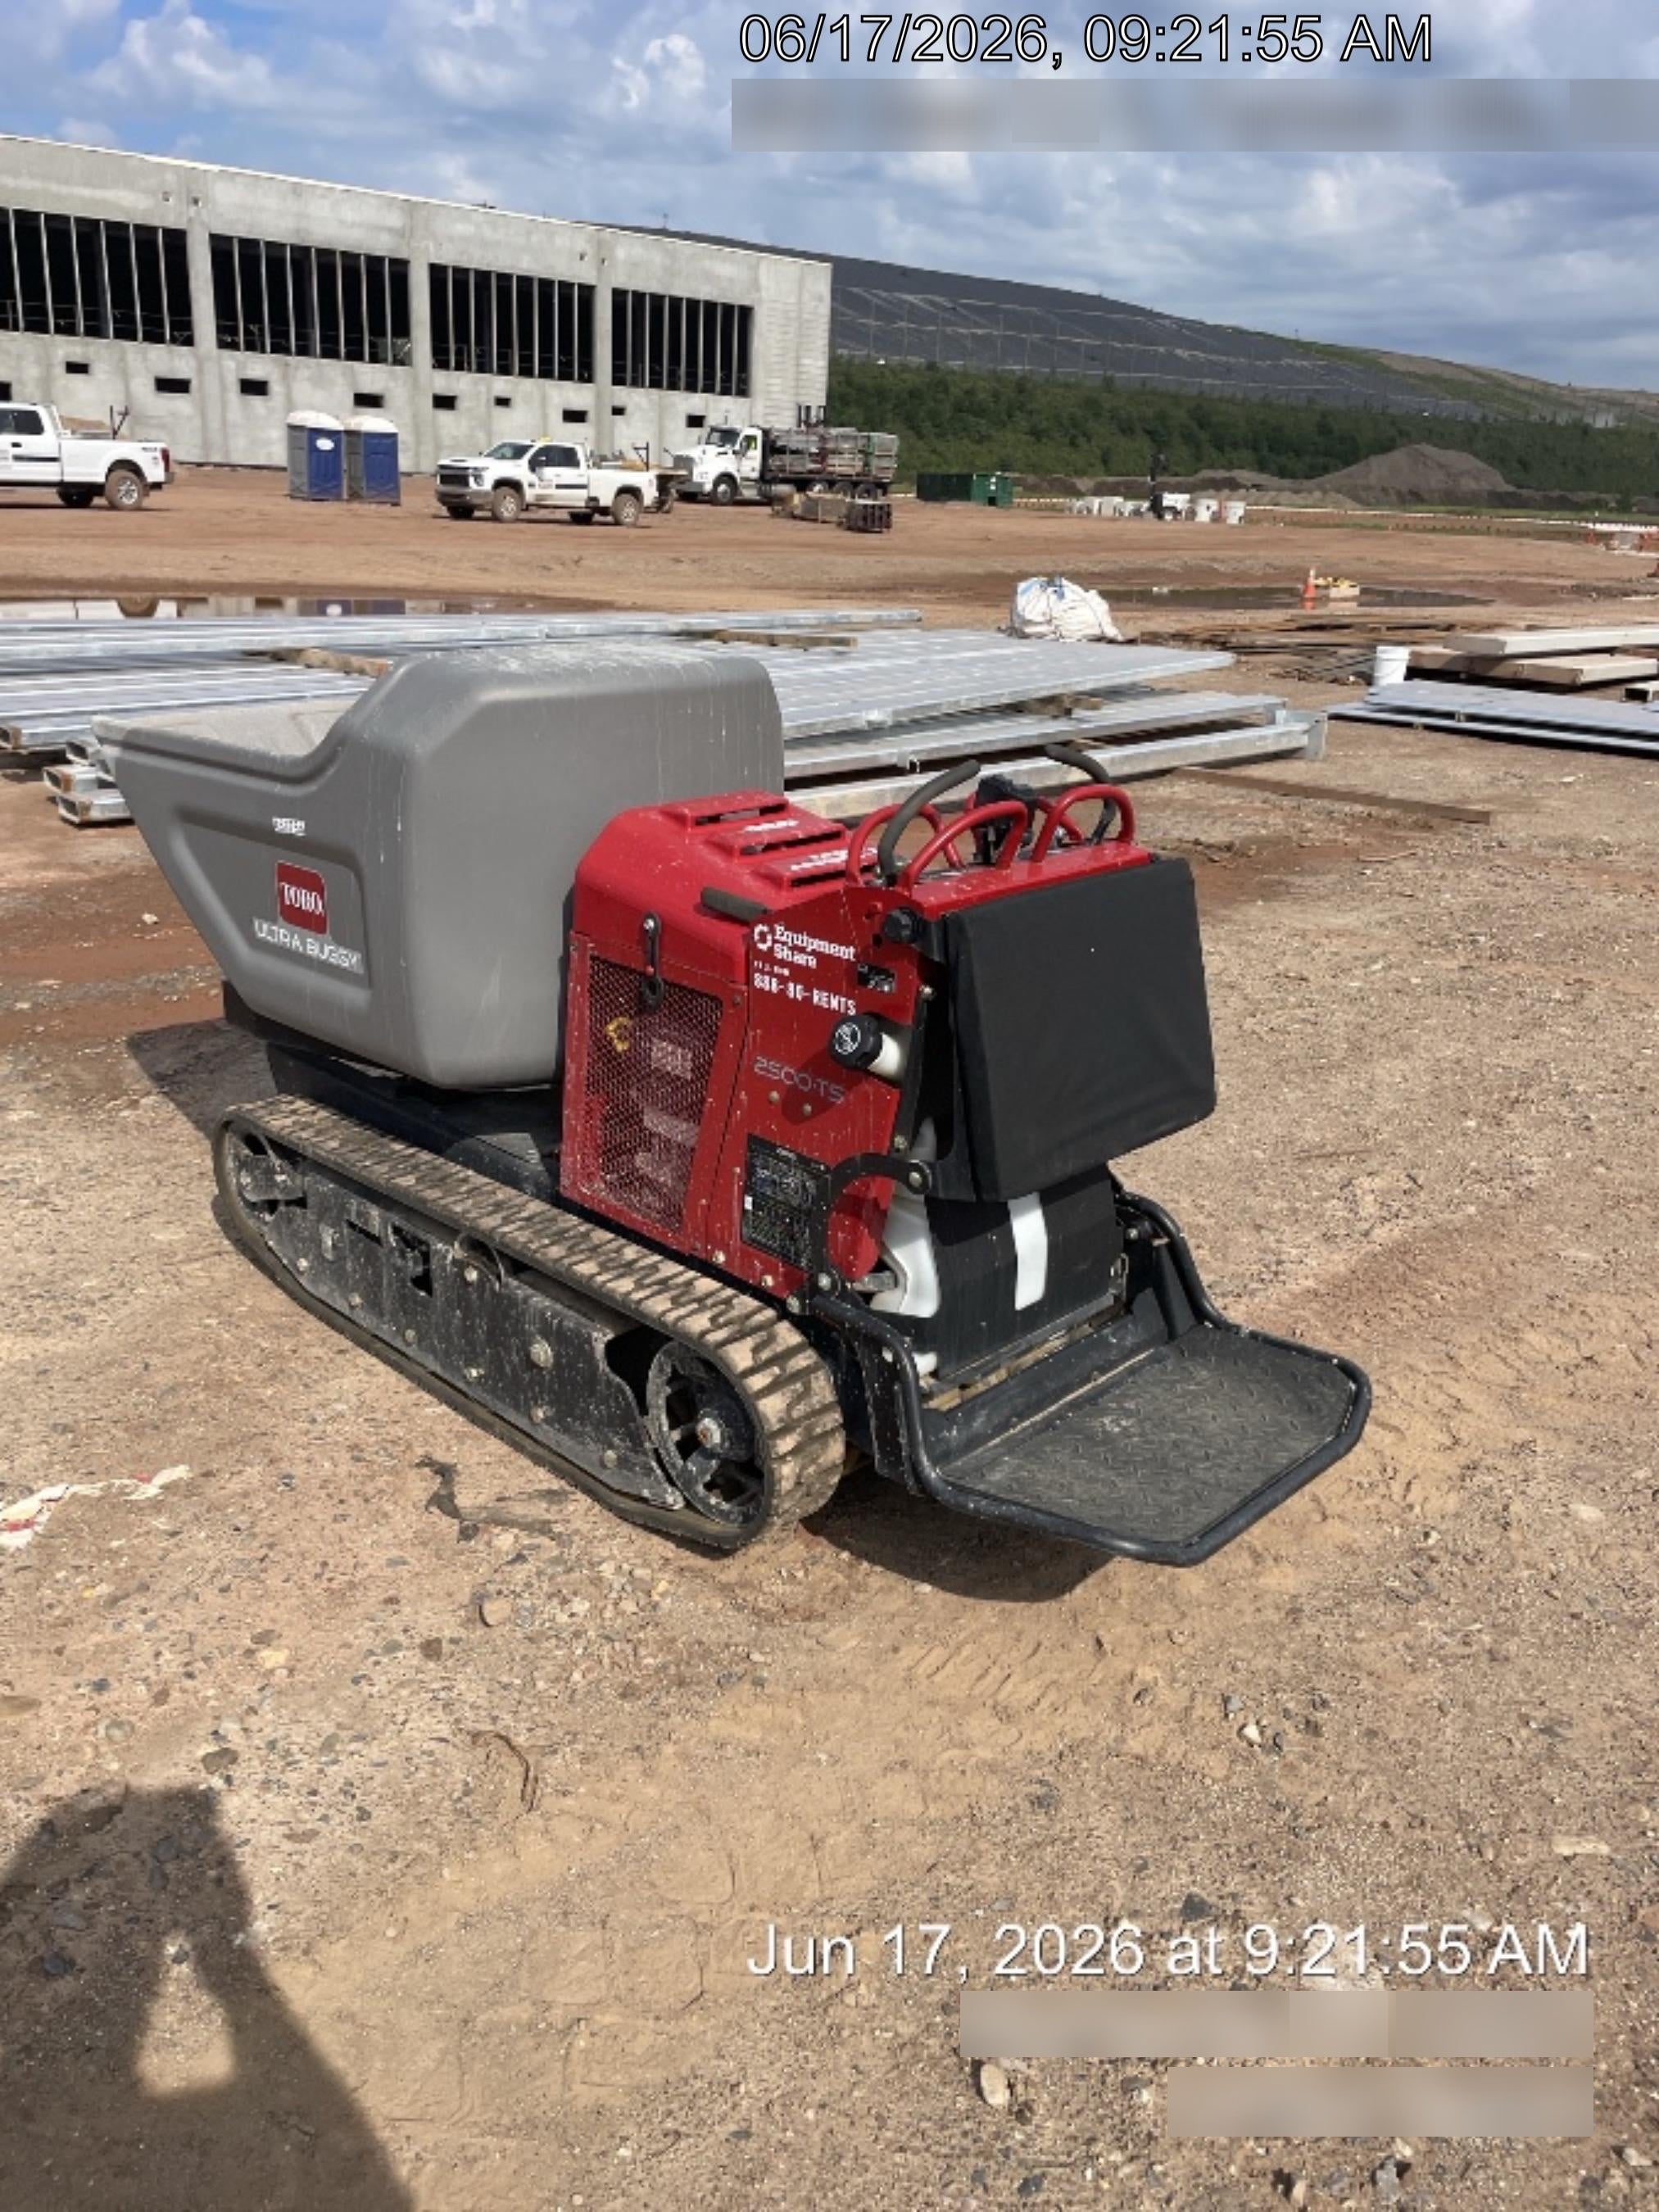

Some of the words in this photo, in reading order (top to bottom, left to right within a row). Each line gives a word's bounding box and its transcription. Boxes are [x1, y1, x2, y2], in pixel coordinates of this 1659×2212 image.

[279, 882, 324, 916] TORO
[252, 916, 302, 953] ULTRA
[773, 922, 856, 961] Equipment
[773, 943, 817, 969] Share
